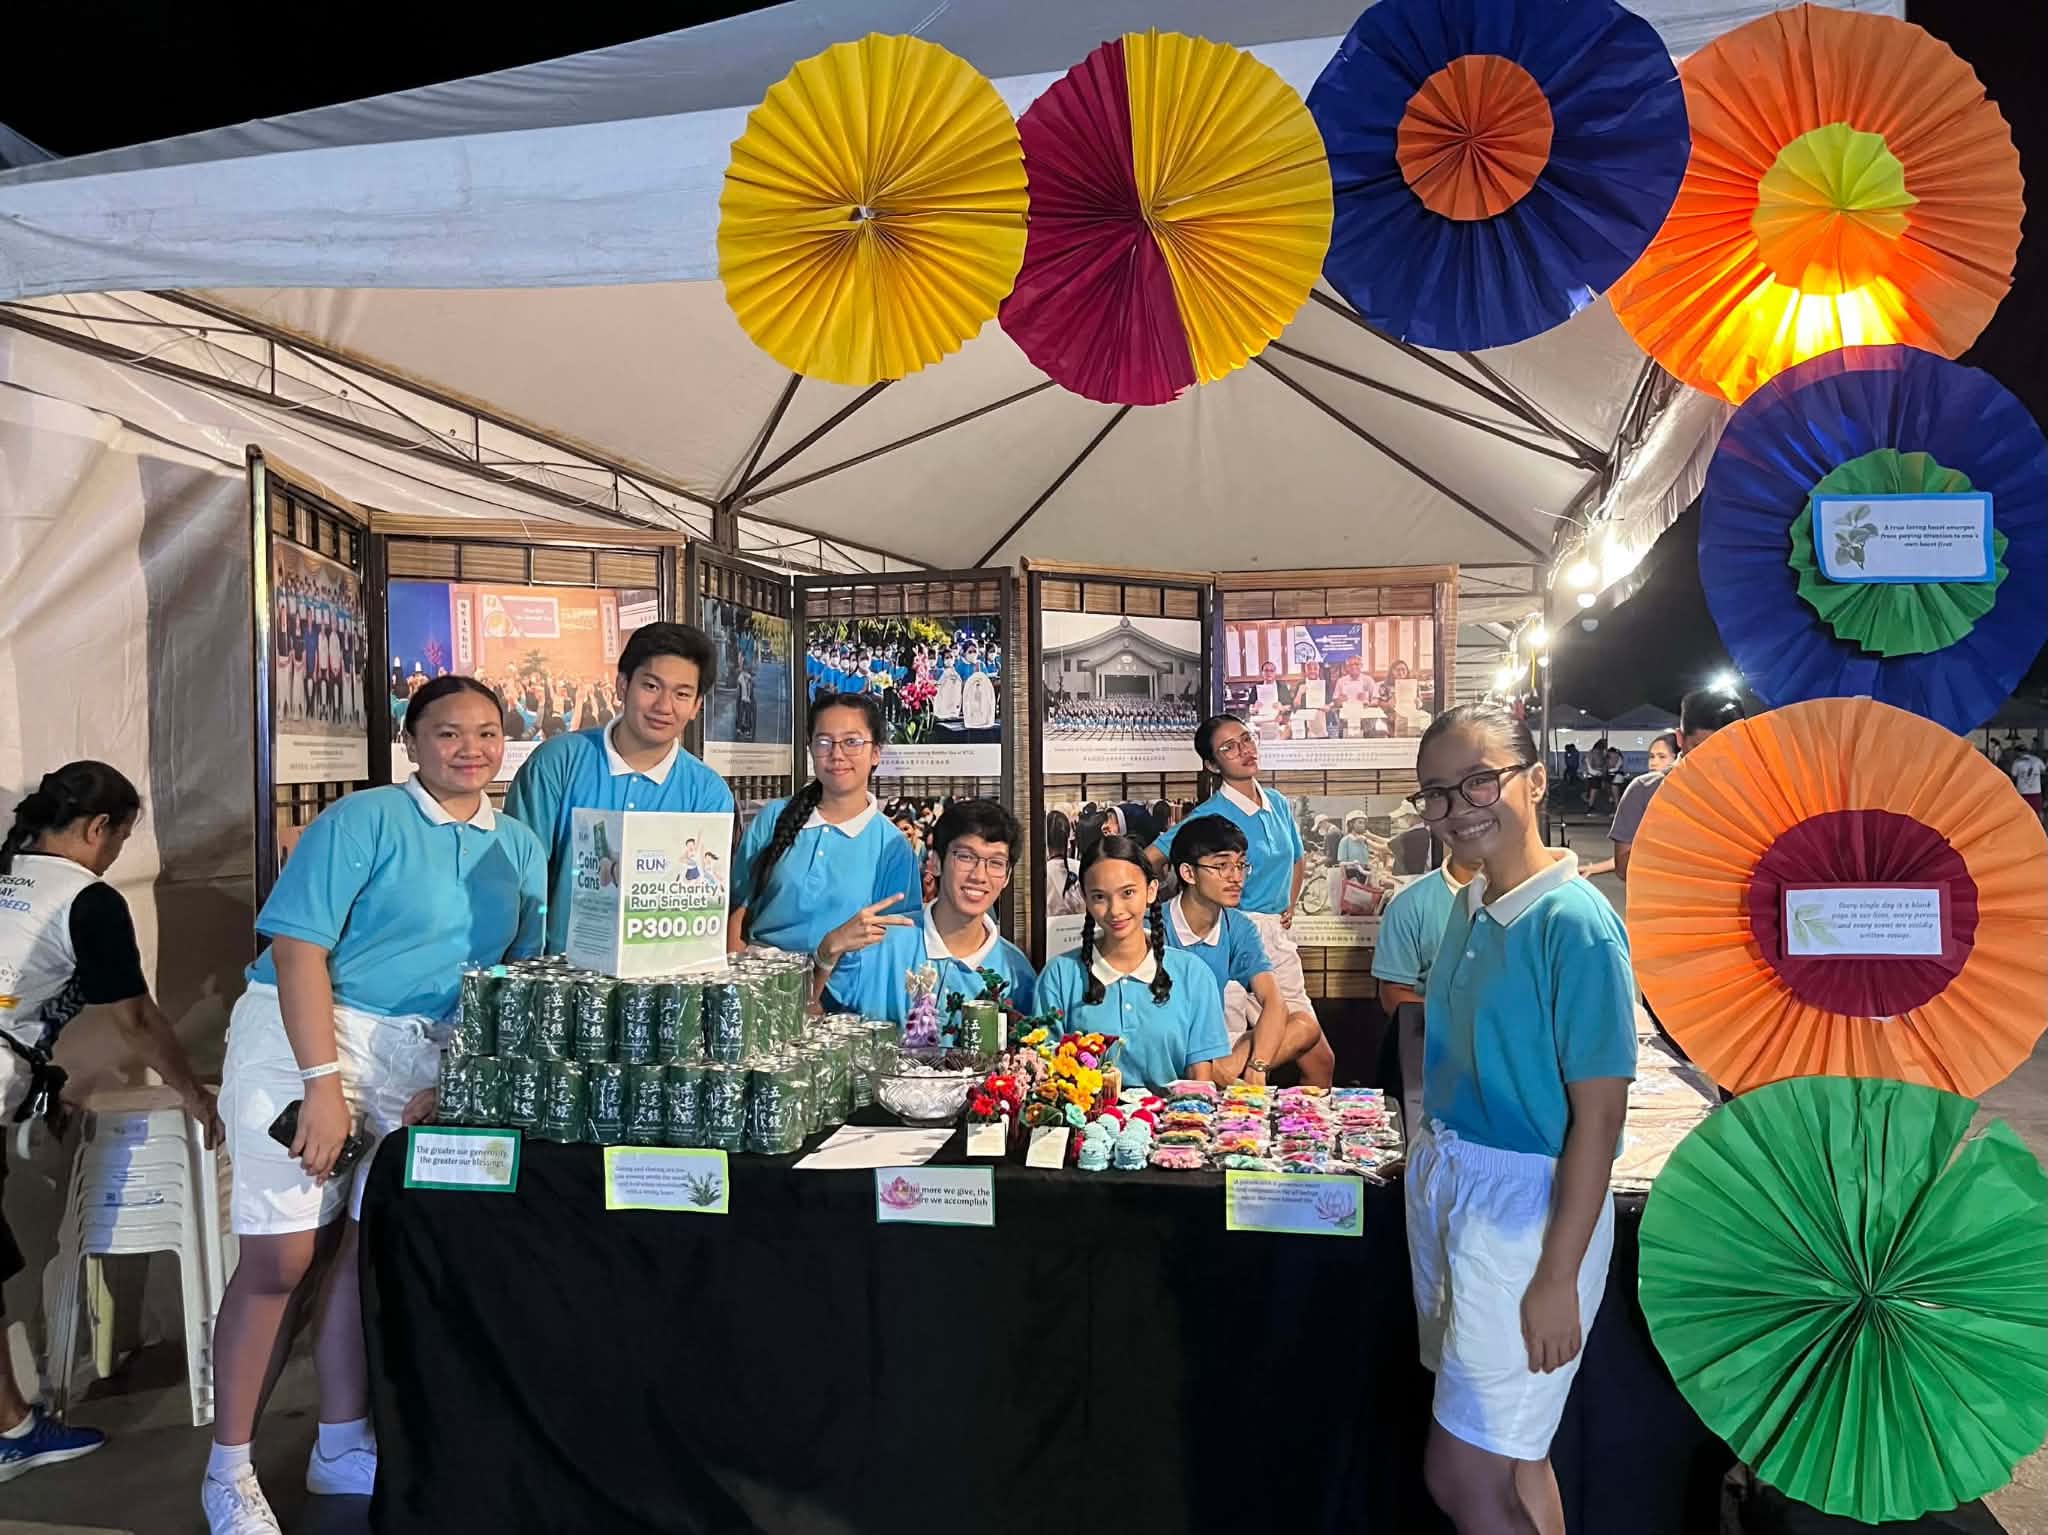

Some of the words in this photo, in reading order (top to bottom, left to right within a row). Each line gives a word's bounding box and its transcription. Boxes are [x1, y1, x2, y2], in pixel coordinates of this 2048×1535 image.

[636, 858, 667, 871] RUN
[577, 870, 600, 890] Cans
[631, 882, 666, 896] 2024
[669, 882, 718, 896] Charity
[631, 896, 657, 908] Run
[661, 896, 707, 910] Singlet
[627, 915, 721, 939] P300.00
[416, 1145, 429, 1154] The
[430, 1147, 456, 1156] greater
[432, 1157, 458, 1166] greater
[957, 1187, 976, 1197] give,
[977, 1187, 991, 1196] the
[944, 1196, 988, 1207] accomplish
